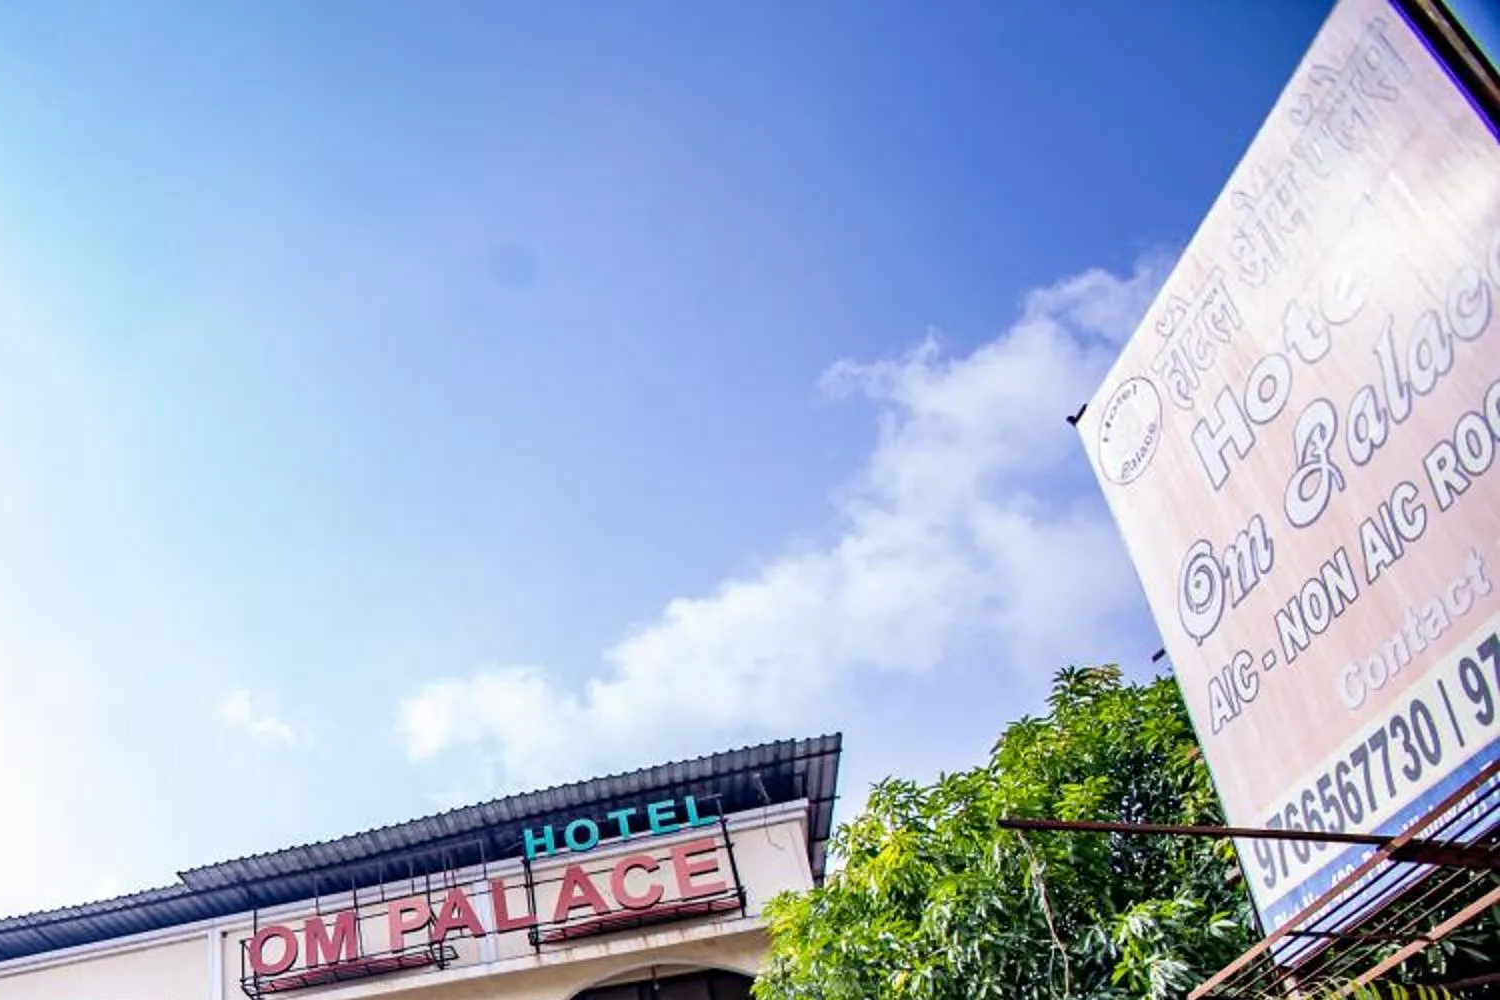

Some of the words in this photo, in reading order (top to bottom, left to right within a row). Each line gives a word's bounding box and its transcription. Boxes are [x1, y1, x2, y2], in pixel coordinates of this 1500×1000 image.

[1178, 514, 1274, 645] Om
[1274, 547, 1360, 664] NON
[523, 795, 718, 861] HOTEL
[248, 908, 358, 977] OM
[388, 838, 728, 952] PALACE
